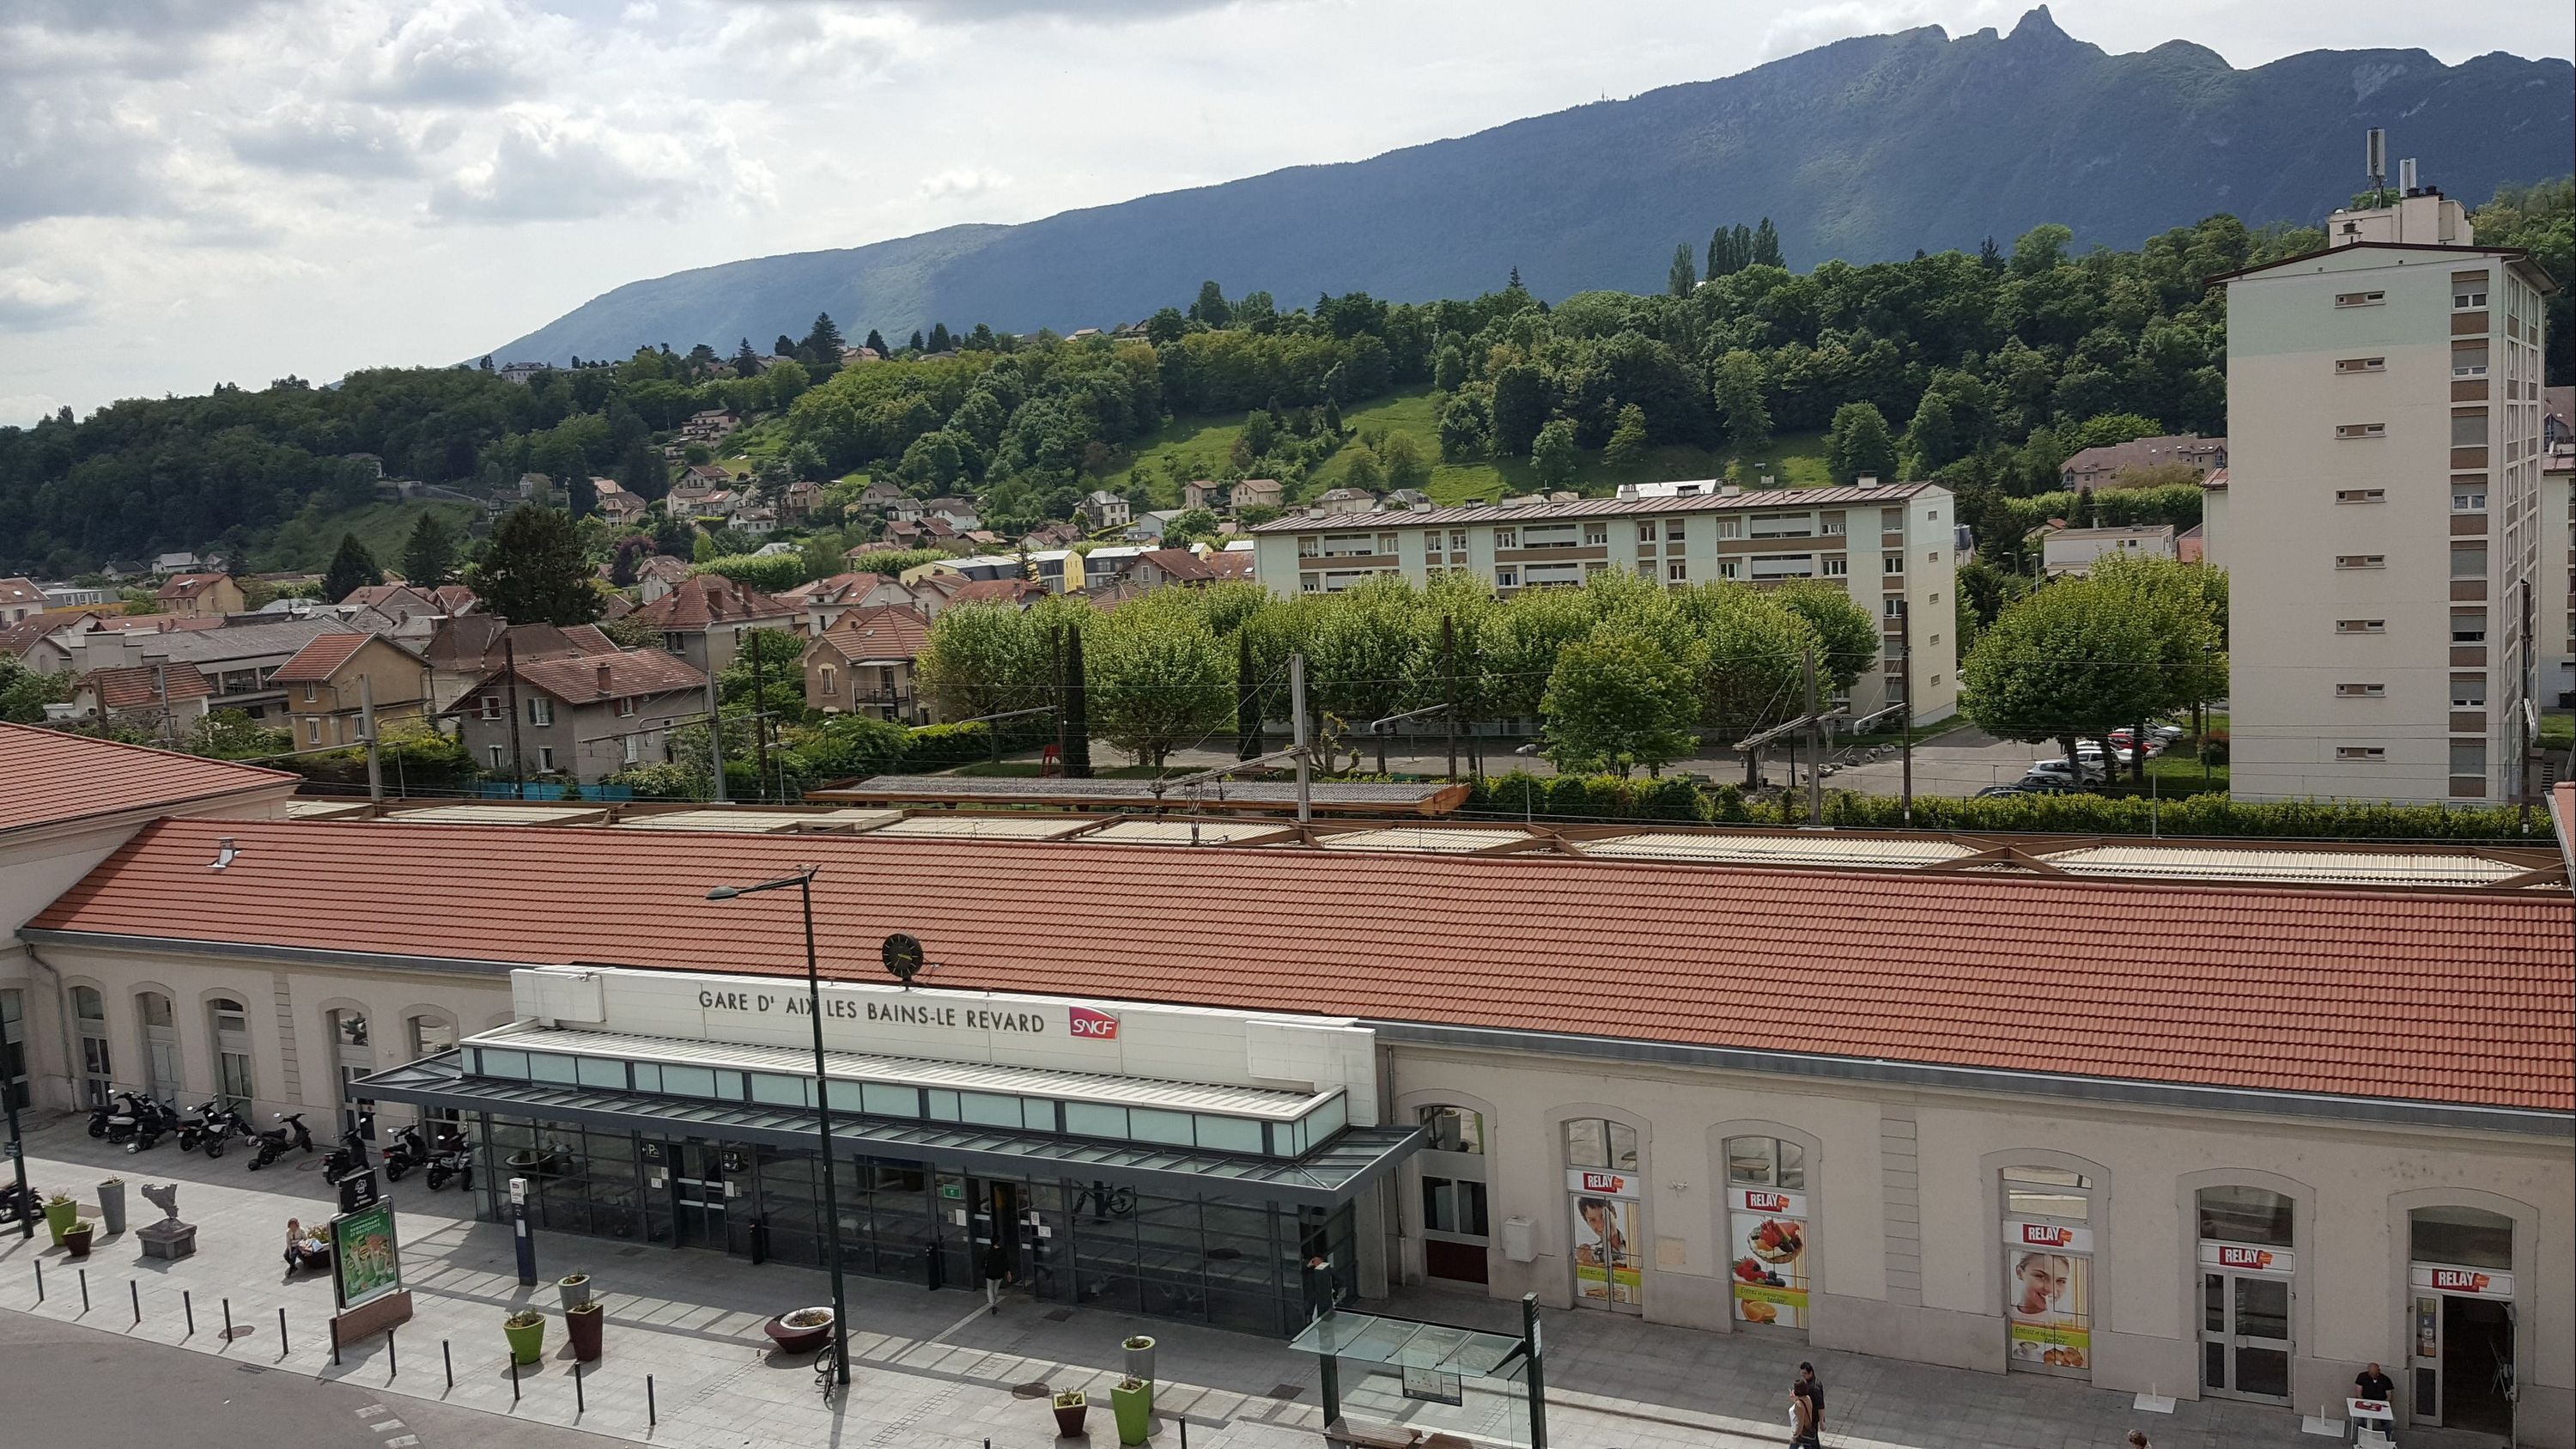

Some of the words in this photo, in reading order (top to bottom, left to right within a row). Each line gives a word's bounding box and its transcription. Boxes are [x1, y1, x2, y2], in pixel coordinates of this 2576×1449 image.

[699, 990, 748, 1011] GARE
[757, 995, 775, 1012] D'
[827, 999, 858, 1019] LES
[867, 1002, 957, 1026] BAINS-LE
[967, 1009, 1045, 1032] REVARD
[1072, 1019, 1115, 1035] SNCF
[1588, 1174, 1613, 1188] RELAY
[1750, 1193, 1778, 1207] RELAY
[2028, 1227, 2060, 1241] RELAY
[2225, 1248, 2259, 1263] RELAY
[2439, 1270, 2474, 1287] RELAY
